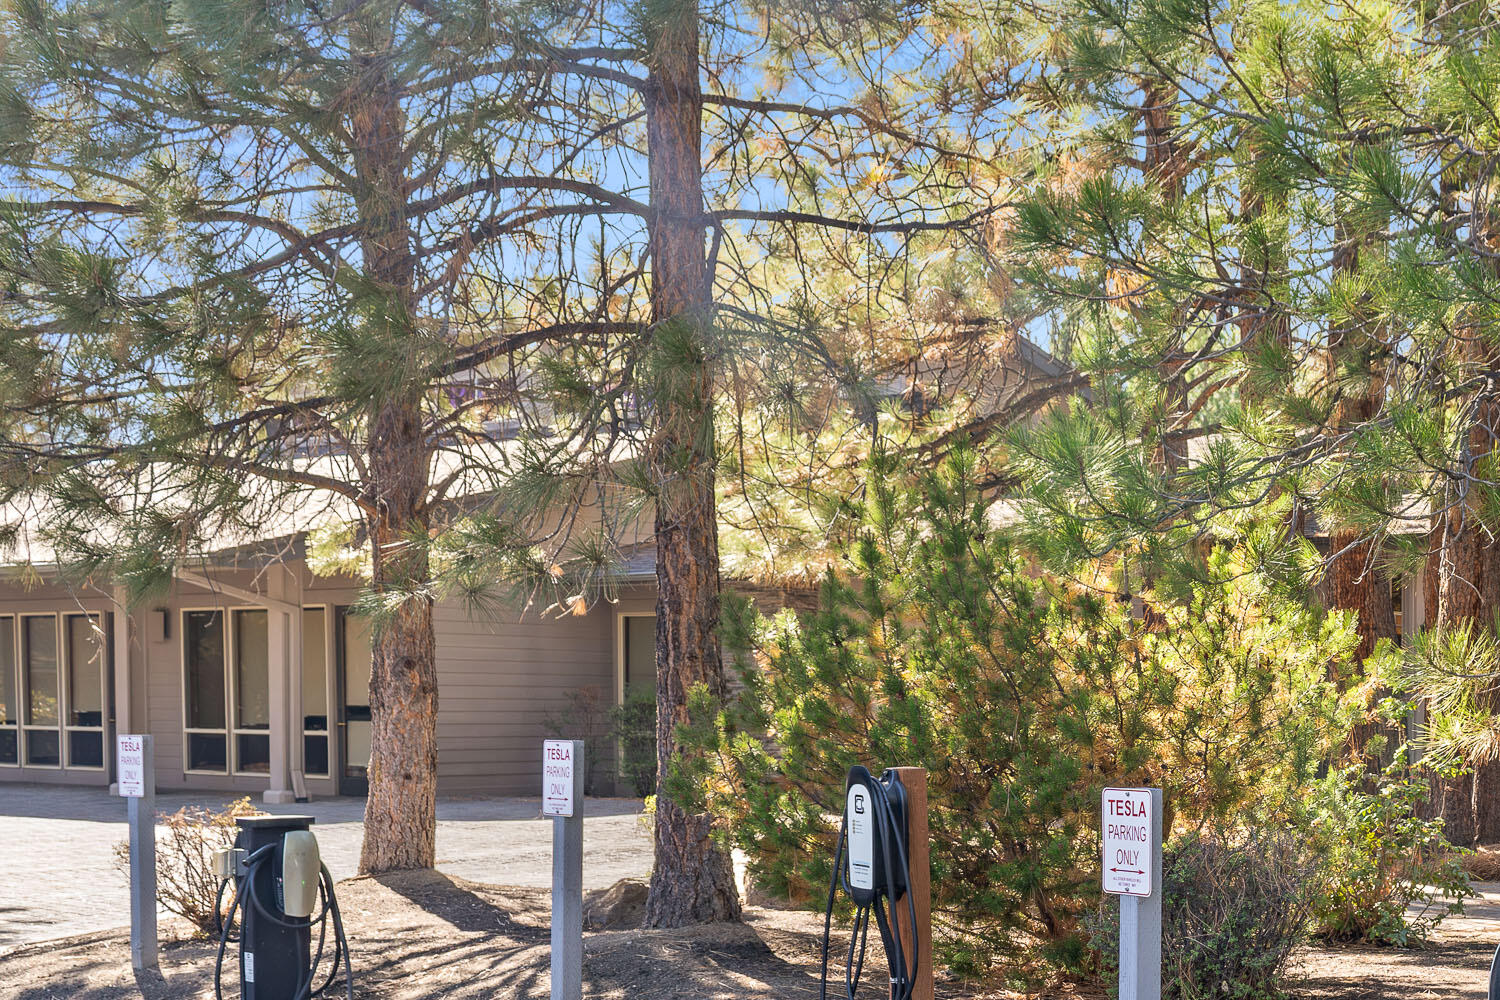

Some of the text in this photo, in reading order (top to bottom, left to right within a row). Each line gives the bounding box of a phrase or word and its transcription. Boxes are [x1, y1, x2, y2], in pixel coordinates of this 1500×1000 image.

[547, 748, 570, 761] TESLA
[546, 766, 570, 778] PARKING
[551, 783, 565, 796] ONLY
[1108, 799, 1147, 818] TESLA
[1108, 824, 1147, 842] PARKING
[1116, 848, 1140, 866] ONLY
